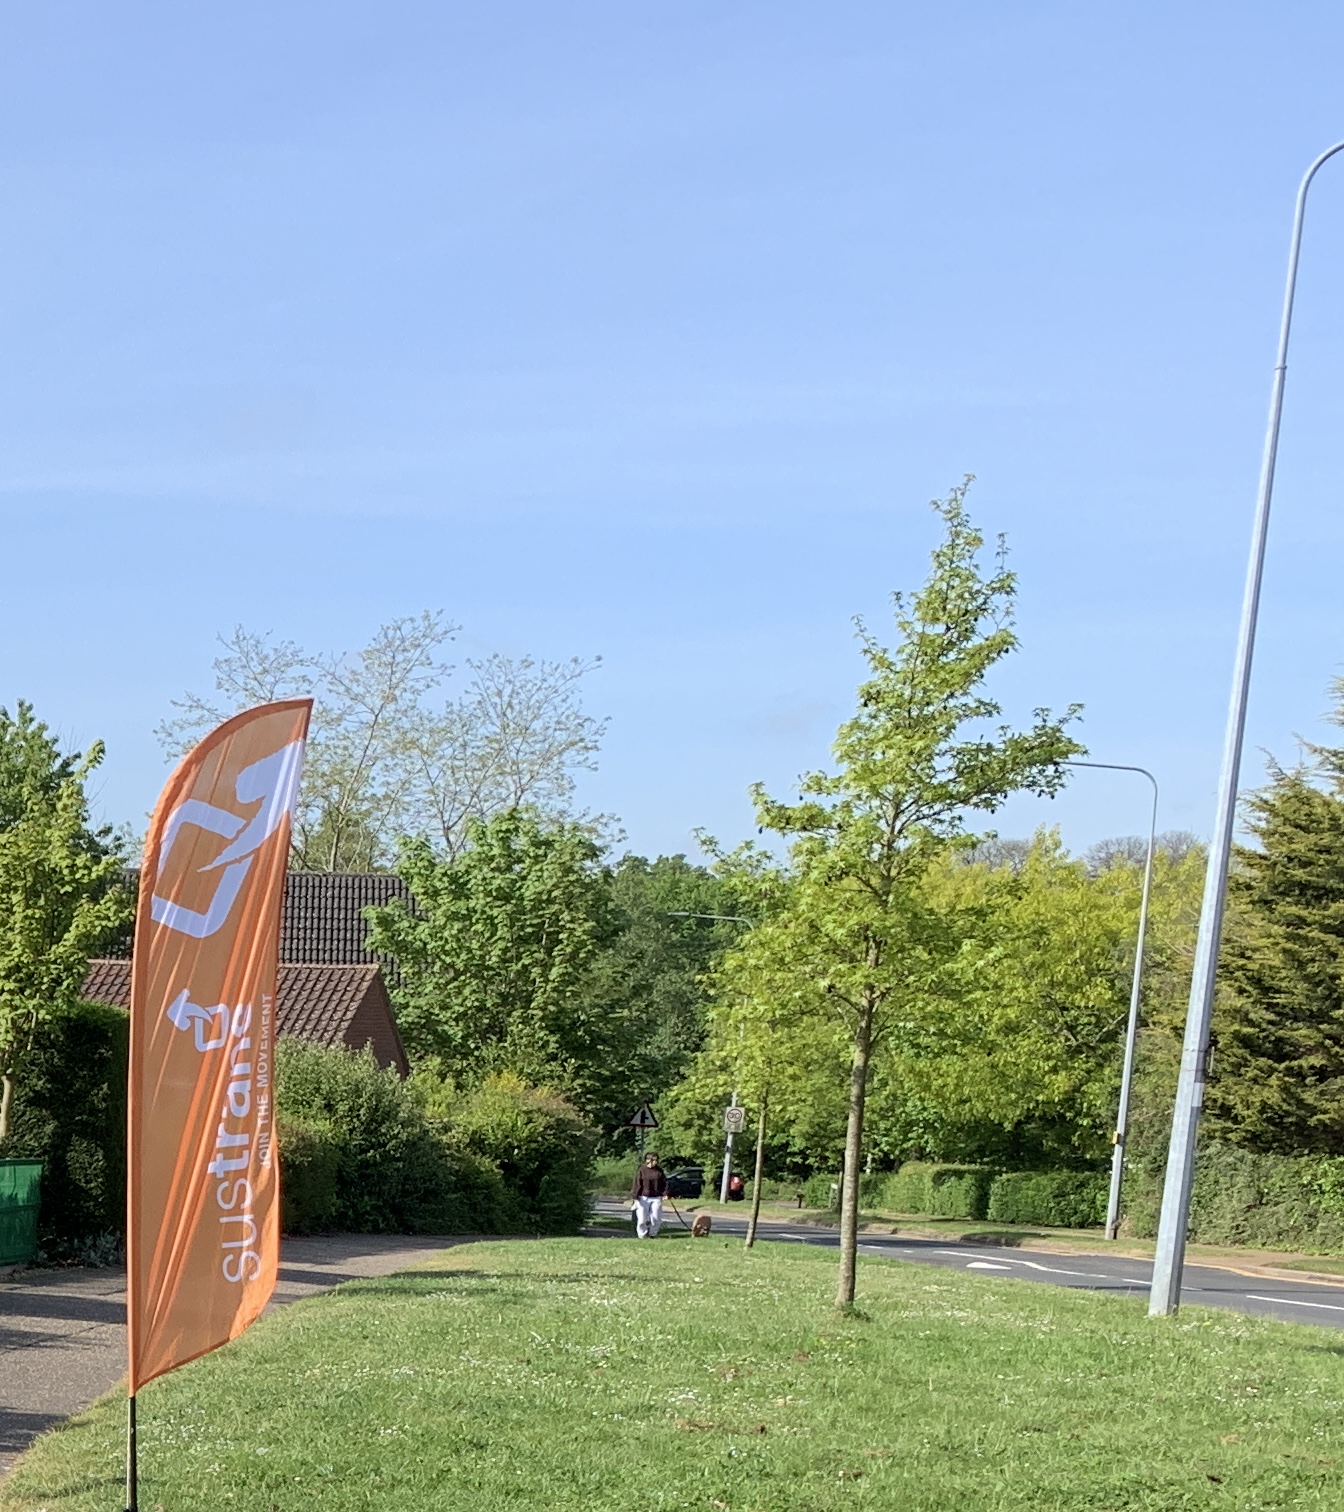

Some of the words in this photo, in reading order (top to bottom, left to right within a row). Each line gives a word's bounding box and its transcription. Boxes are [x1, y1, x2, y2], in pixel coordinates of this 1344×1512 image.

[256, 993, 273, 1088] MOVEMENT
[207, 1002, 261, 1283] sustrans
[256, 1093, 270, 1128] THE
[258, 1128, 272, 1169] JOIN
